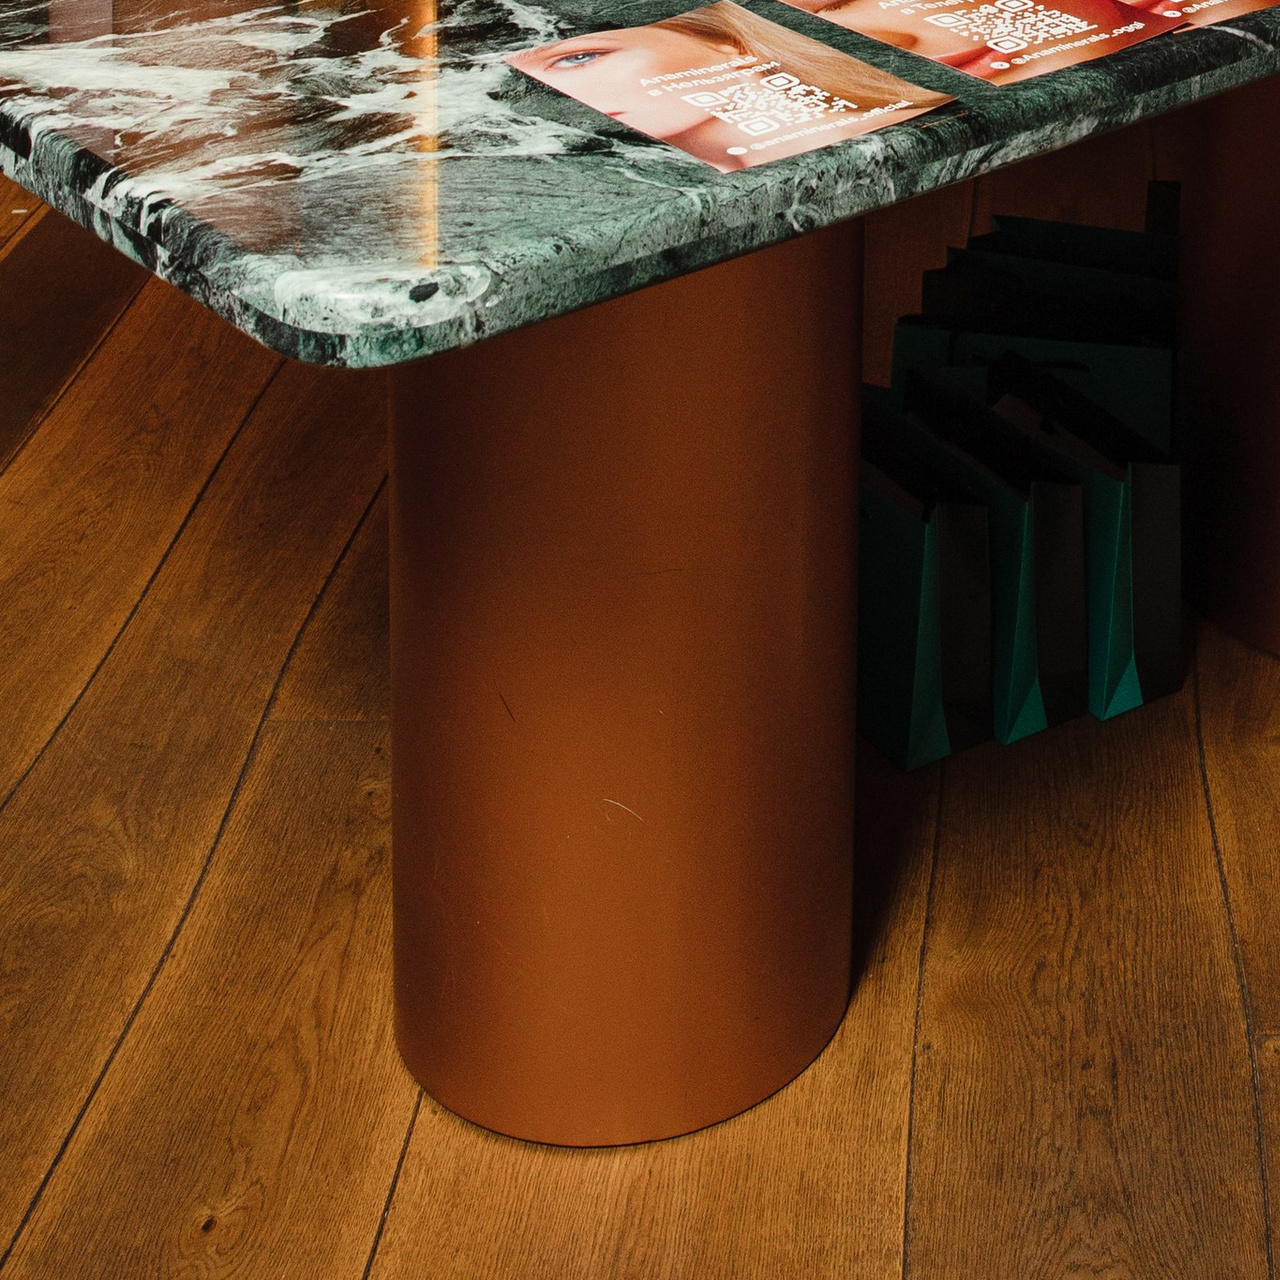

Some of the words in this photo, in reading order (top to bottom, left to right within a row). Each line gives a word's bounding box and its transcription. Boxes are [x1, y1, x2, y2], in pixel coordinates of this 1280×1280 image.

[1011, 20, 1146, 66] @Anaminerals_oggi
[639, 55, 758, 87] Anaminerals
[661, 60, 782, 92] Нельзяграм
[750, 99, 914, 151] @anaminerals_official
